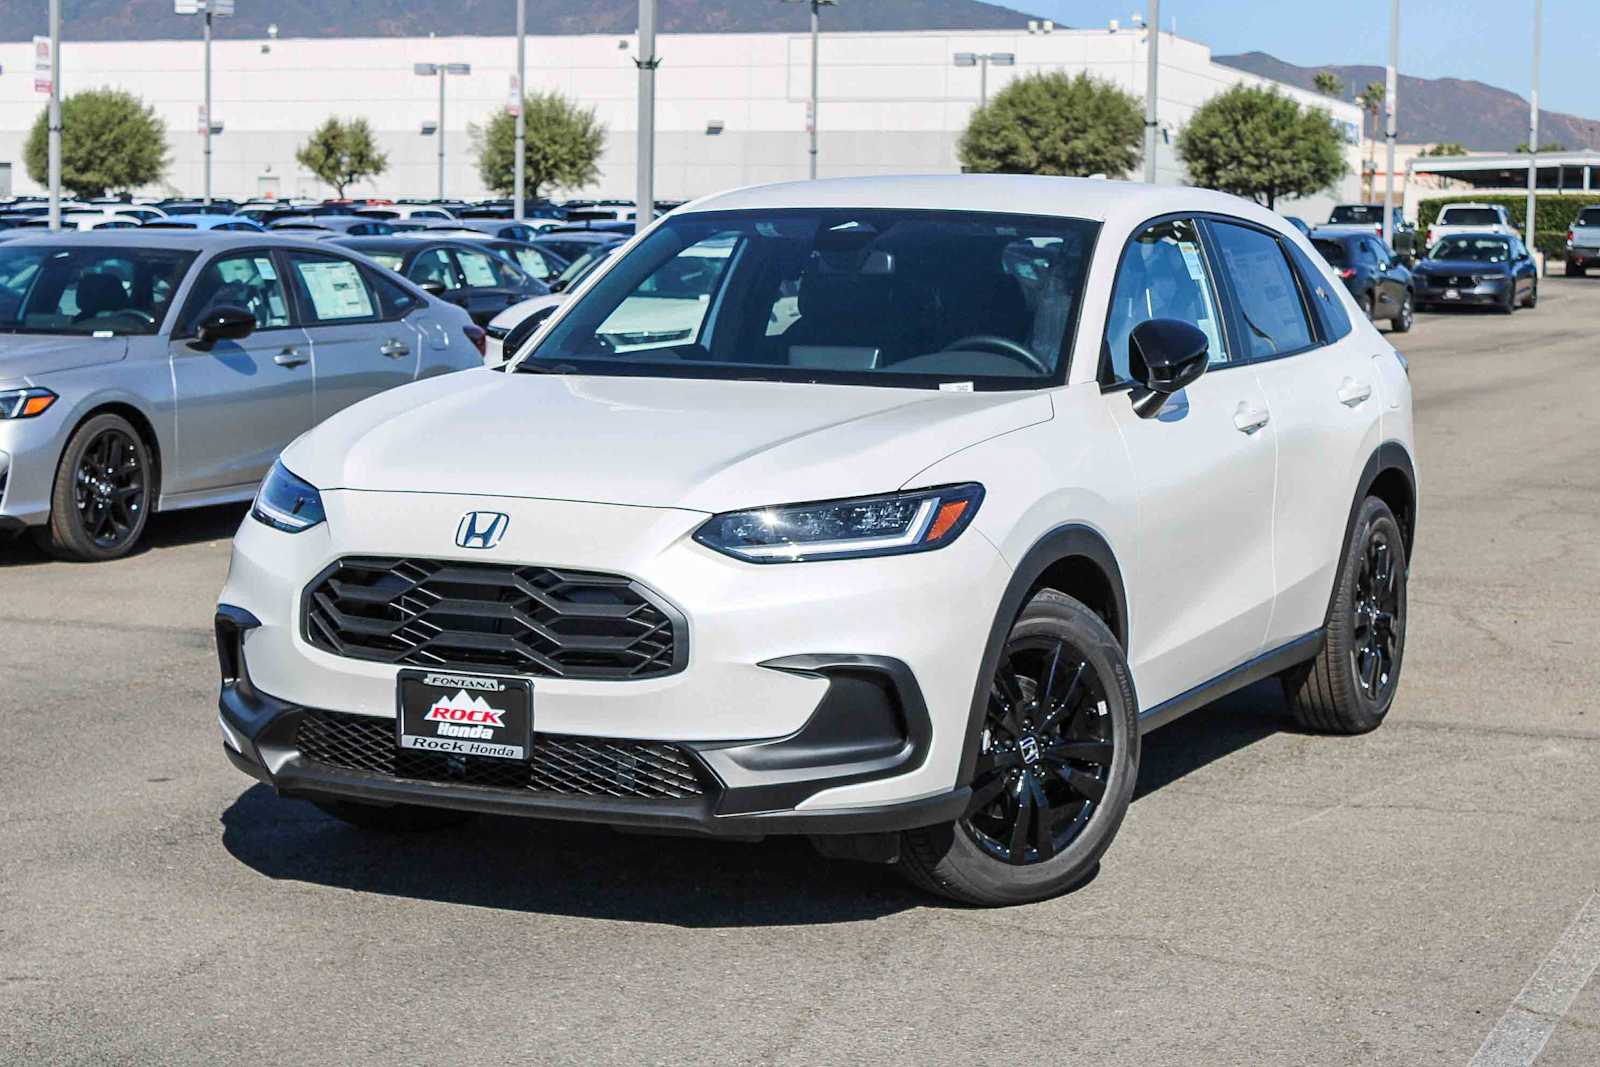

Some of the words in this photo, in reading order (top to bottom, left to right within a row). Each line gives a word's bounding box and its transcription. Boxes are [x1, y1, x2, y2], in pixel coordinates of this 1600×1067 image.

[431, 677, 496, 689] FONTANA
[431, 707, 499, 724] ROCK
[436, 722, 494, 740] Honda
[412, 737, 465, 752] Rock
[469, 743, 515, 757] Honda
